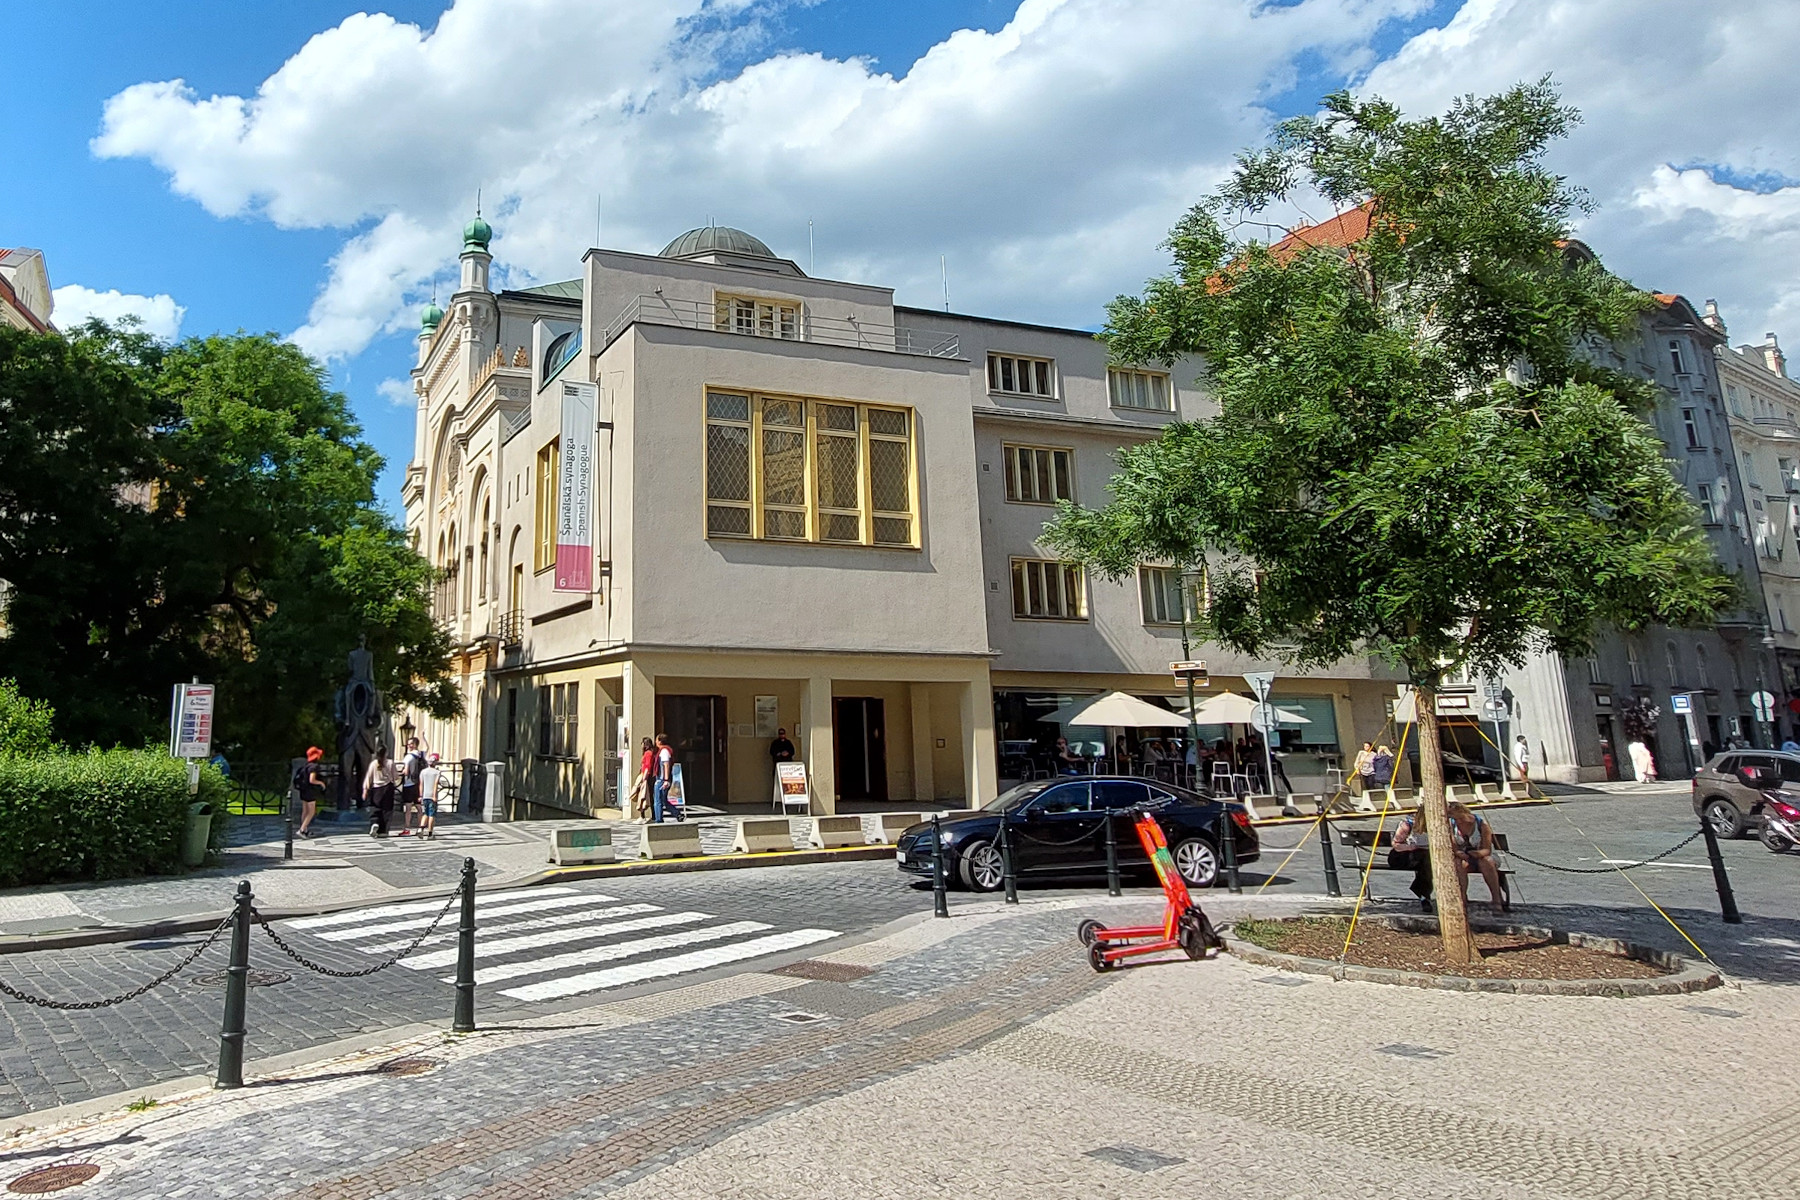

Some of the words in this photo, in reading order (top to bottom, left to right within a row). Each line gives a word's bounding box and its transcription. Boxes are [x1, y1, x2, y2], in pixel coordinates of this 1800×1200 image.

[559, 487, 572, 536] Španělská
[566, 438, 575, 483] synagoga
[577, 444, 589, 496] Synagogue
[576, 500, 587, 537] Spanish
[560, 577, 566, 587] 6
